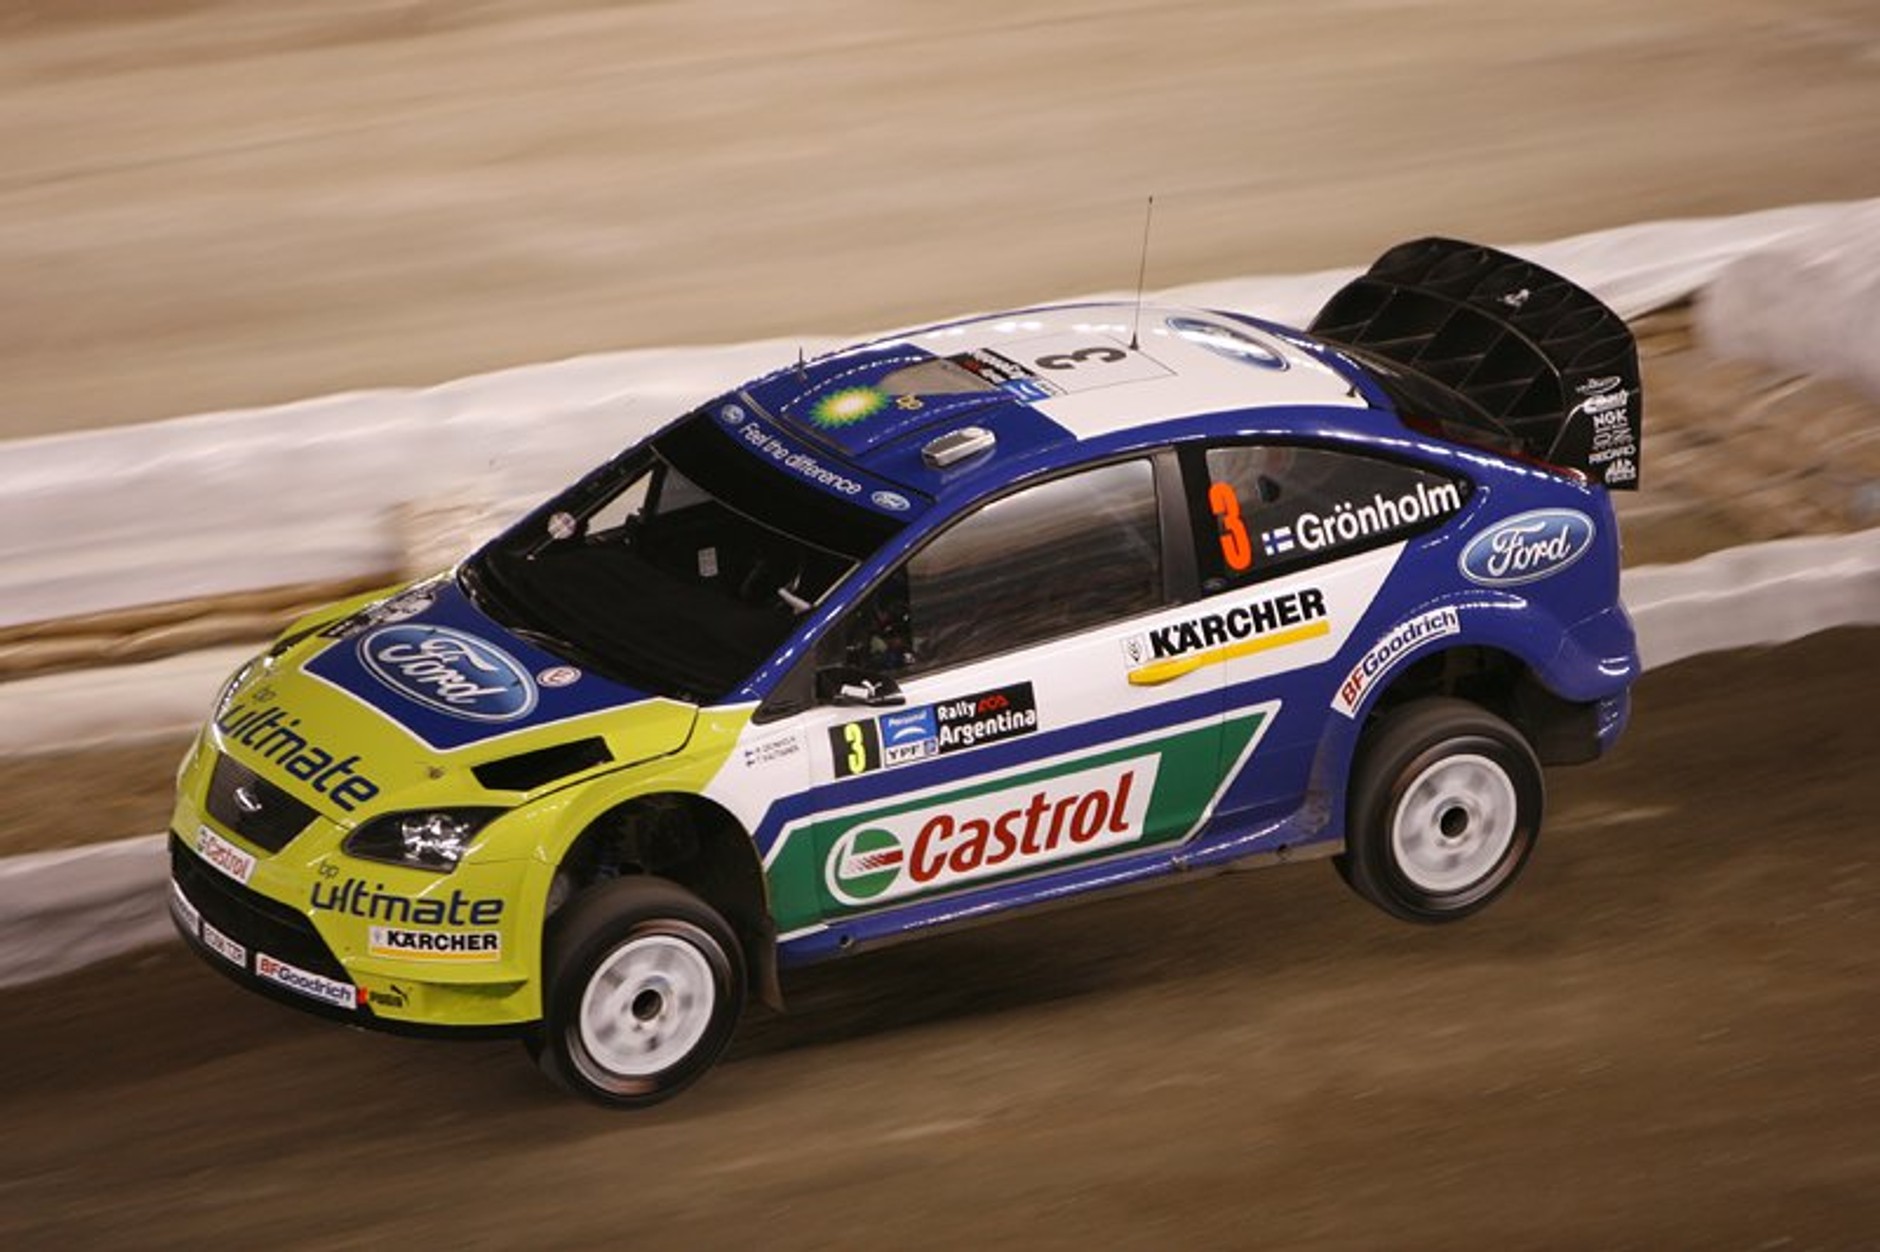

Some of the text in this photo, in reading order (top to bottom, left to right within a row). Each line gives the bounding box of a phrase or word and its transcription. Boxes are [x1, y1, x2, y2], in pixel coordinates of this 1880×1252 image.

[1593, 409, 1627, 429] NGK
[739, 423, 862, 495] Feel the difference
[1208, 481, 1251, 570] 3
[1297, 482, 1461, 551] Grönholm
[1487, 529, 1572, 576] Ford
[1149, 588, 1325, 658] KÄRCHER
[378, 638, 507, 704] Ford
[1341, 611, 1457, 706] BFGoodrich
[937, 700, 977, 722] Rally
[940, 709, 1036, 746] Argentina
[218, 705, 380, 812] ultimate
[844, 723, 867, 775] 3
[888, 745, 921, 760] YPF
[909, 771, 1134, 882] Castrol
[309, 878, 504, 926] ultimate
[387, 929, 498, 952] KÄRCHER
[260, 957, 352, 1001] BFGoodrich
